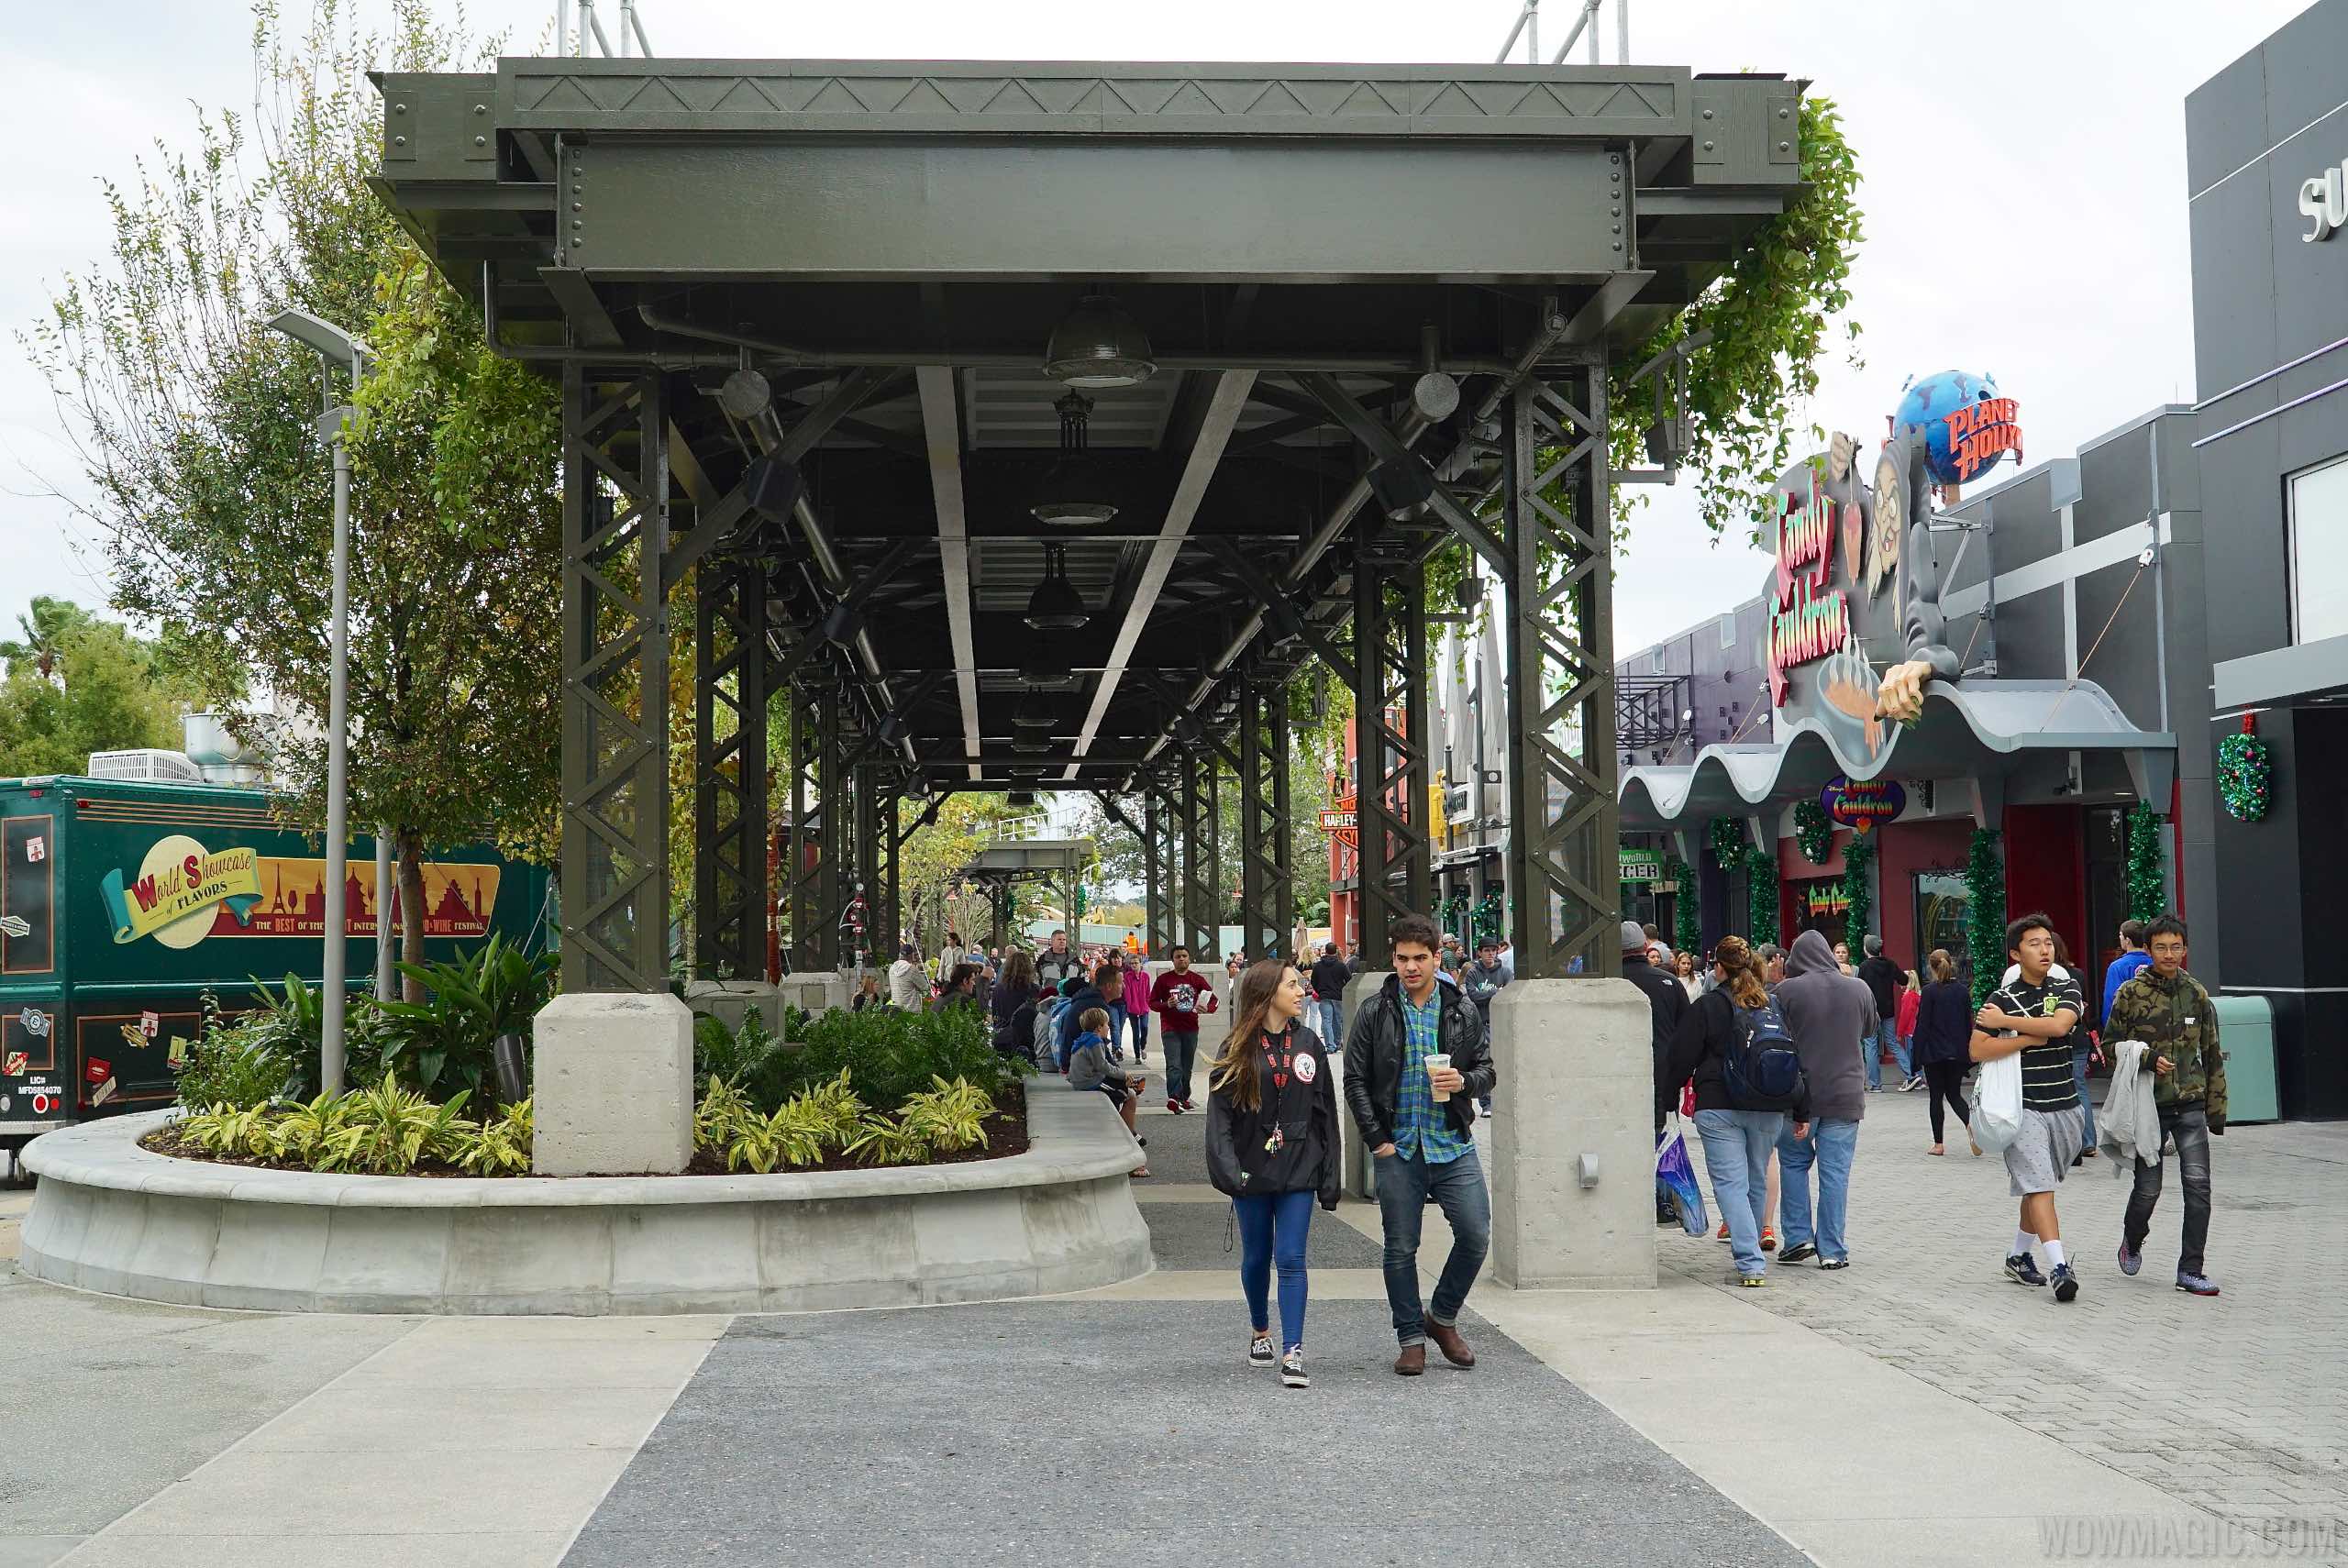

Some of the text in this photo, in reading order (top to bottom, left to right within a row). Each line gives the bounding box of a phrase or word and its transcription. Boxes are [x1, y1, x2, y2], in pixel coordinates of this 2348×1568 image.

[1944, 398, 2020, 454] PLANET
[1776, 469, 1835, 608] Candy
[1767, 572, 1847, 708] Cauldron
[1834, 794, 1893, 822] Cauldron
[131, 852, 251, 913] World Showcase
[177, 880, 227, 910] FLAVORS
[256, 921, 271, 931] THE
[275, 918, 294, 933] BEST
[297, 921, 306, 931] OF
[309, 921, 324, 931] THE
